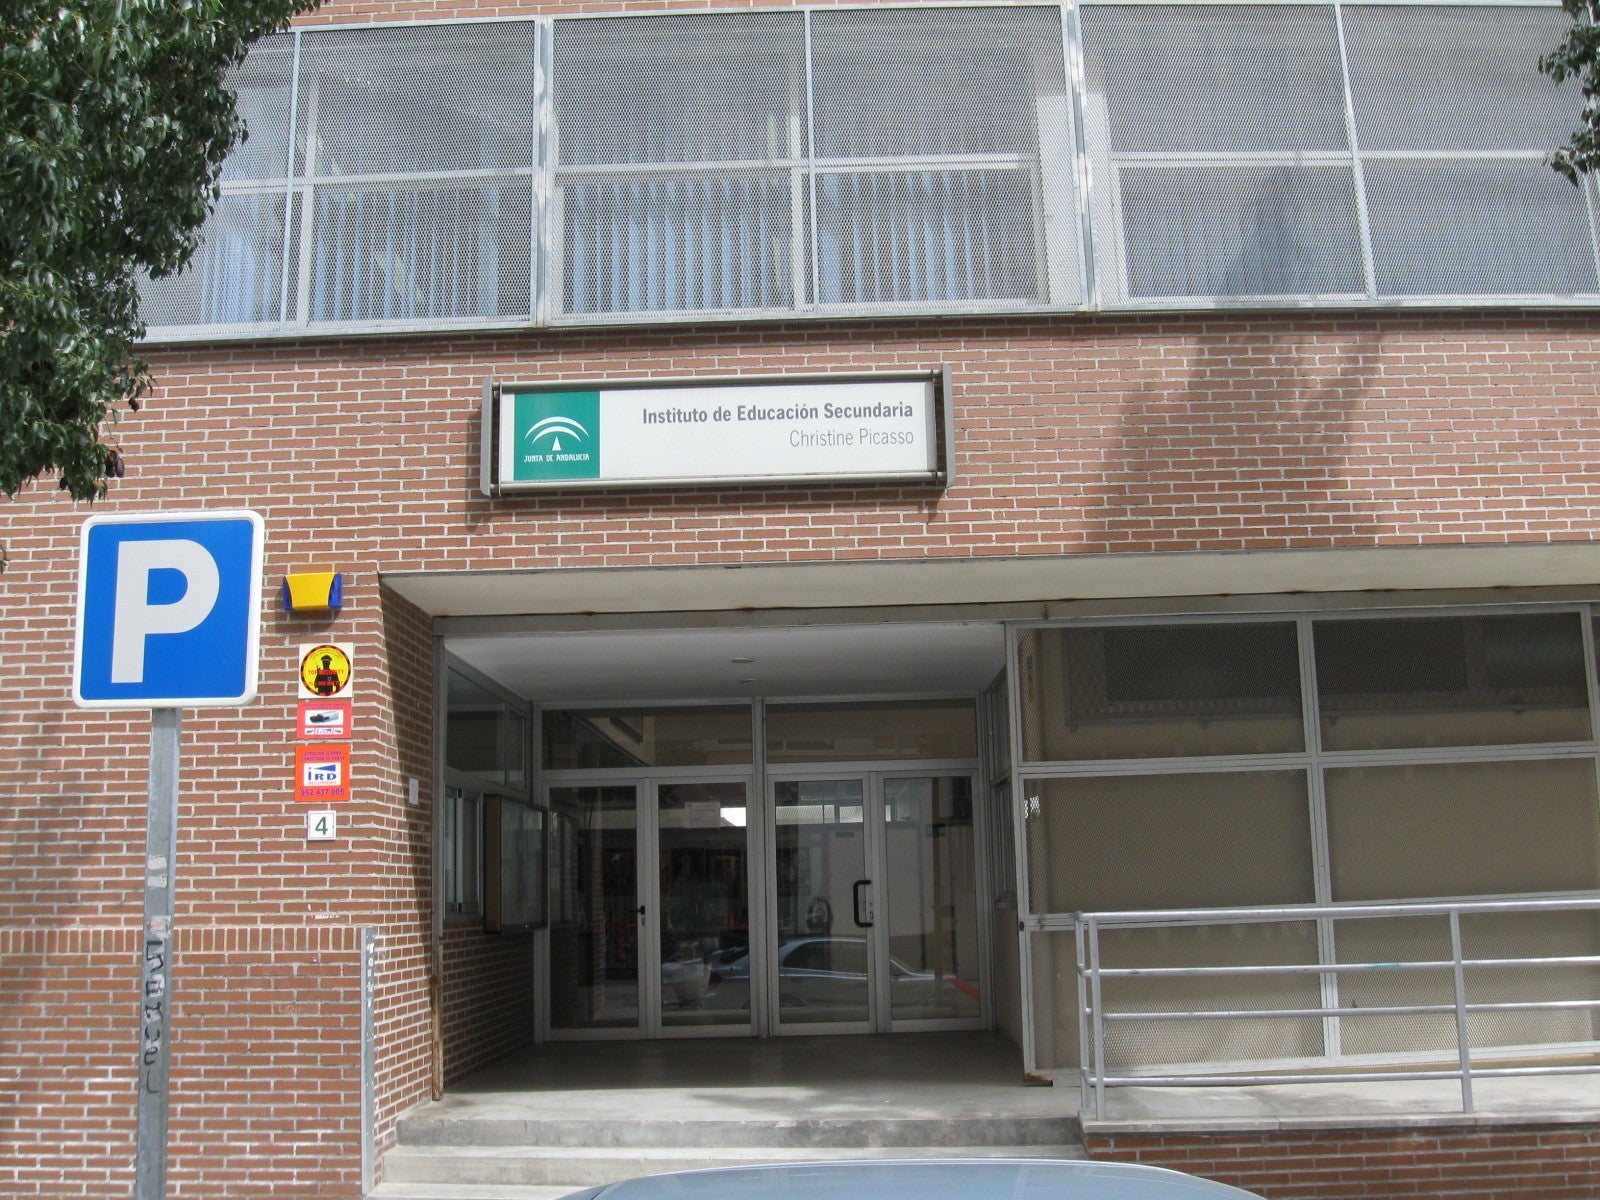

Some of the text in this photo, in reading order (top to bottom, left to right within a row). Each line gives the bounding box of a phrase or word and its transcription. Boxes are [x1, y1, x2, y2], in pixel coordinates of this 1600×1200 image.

[642, 402, 913, 424] Instituto de Educación Secundaria
[790, 428, 914, 447] Christine Picasso
[524, 454, 544, 463] JUNTA
[546, 454, 554, 462] DE
[111, 539, 220, 684] P
[331, 788, 345, 796] 005
[315, 816, 328, 836] 4
